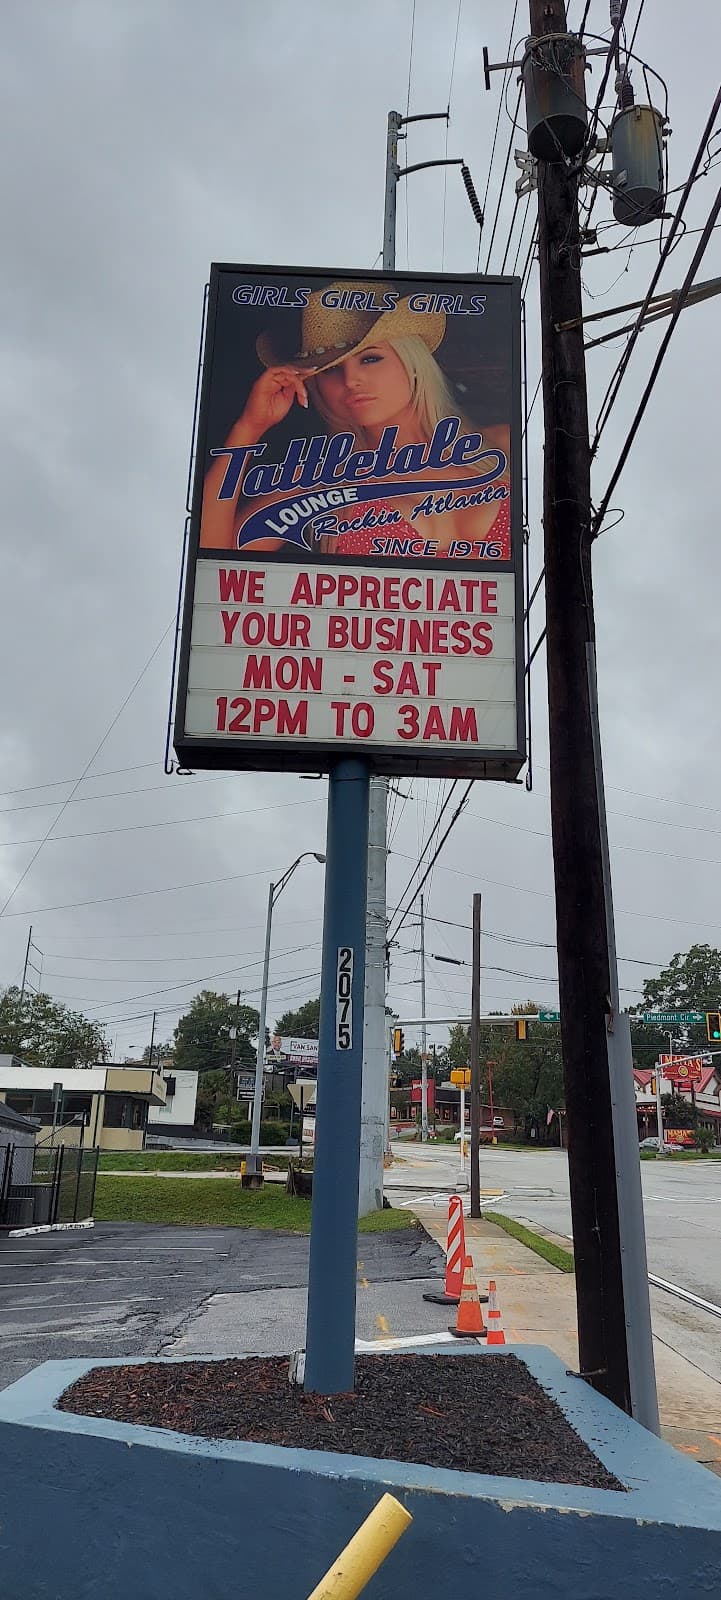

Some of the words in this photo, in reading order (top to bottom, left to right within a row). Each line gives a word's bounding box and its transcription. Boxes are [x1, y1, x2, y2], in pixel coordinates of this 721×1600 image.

[232, 285, 311, 308] GIRLS
[320, 289, 399, 312] GIRLS
[407, 292, 486, 316] GIRLS
[210, 416, 482, 500] Tattletale
[264, 487, 359, 535] LOUNGE
[312, 510, 401, 539] Rockin
[411, 485, 509, 521] Atlanta
[370, 537, 439, 557] SINCE
[448, 540, 502, 558] 1976
[218, 569, 266, 604] WE
[290, 572, 498, 614] APPRECIATE
[220, 610, 311, 648] YOUR
[328, 615, 493, 655] BUSINESS
[242, 654, 323, 691] MON
[372, 659, 441, 696] SAT
[216, 696, 308, 735] 12PM
[331, 701, 375, 738] TO
[397, 704, 479, 742] 3AM
[338, 948, 352, 1049] 2075
[646, 1013, 677, 1021] Piedmont
[680, 1013, 690, 1021] Cir
